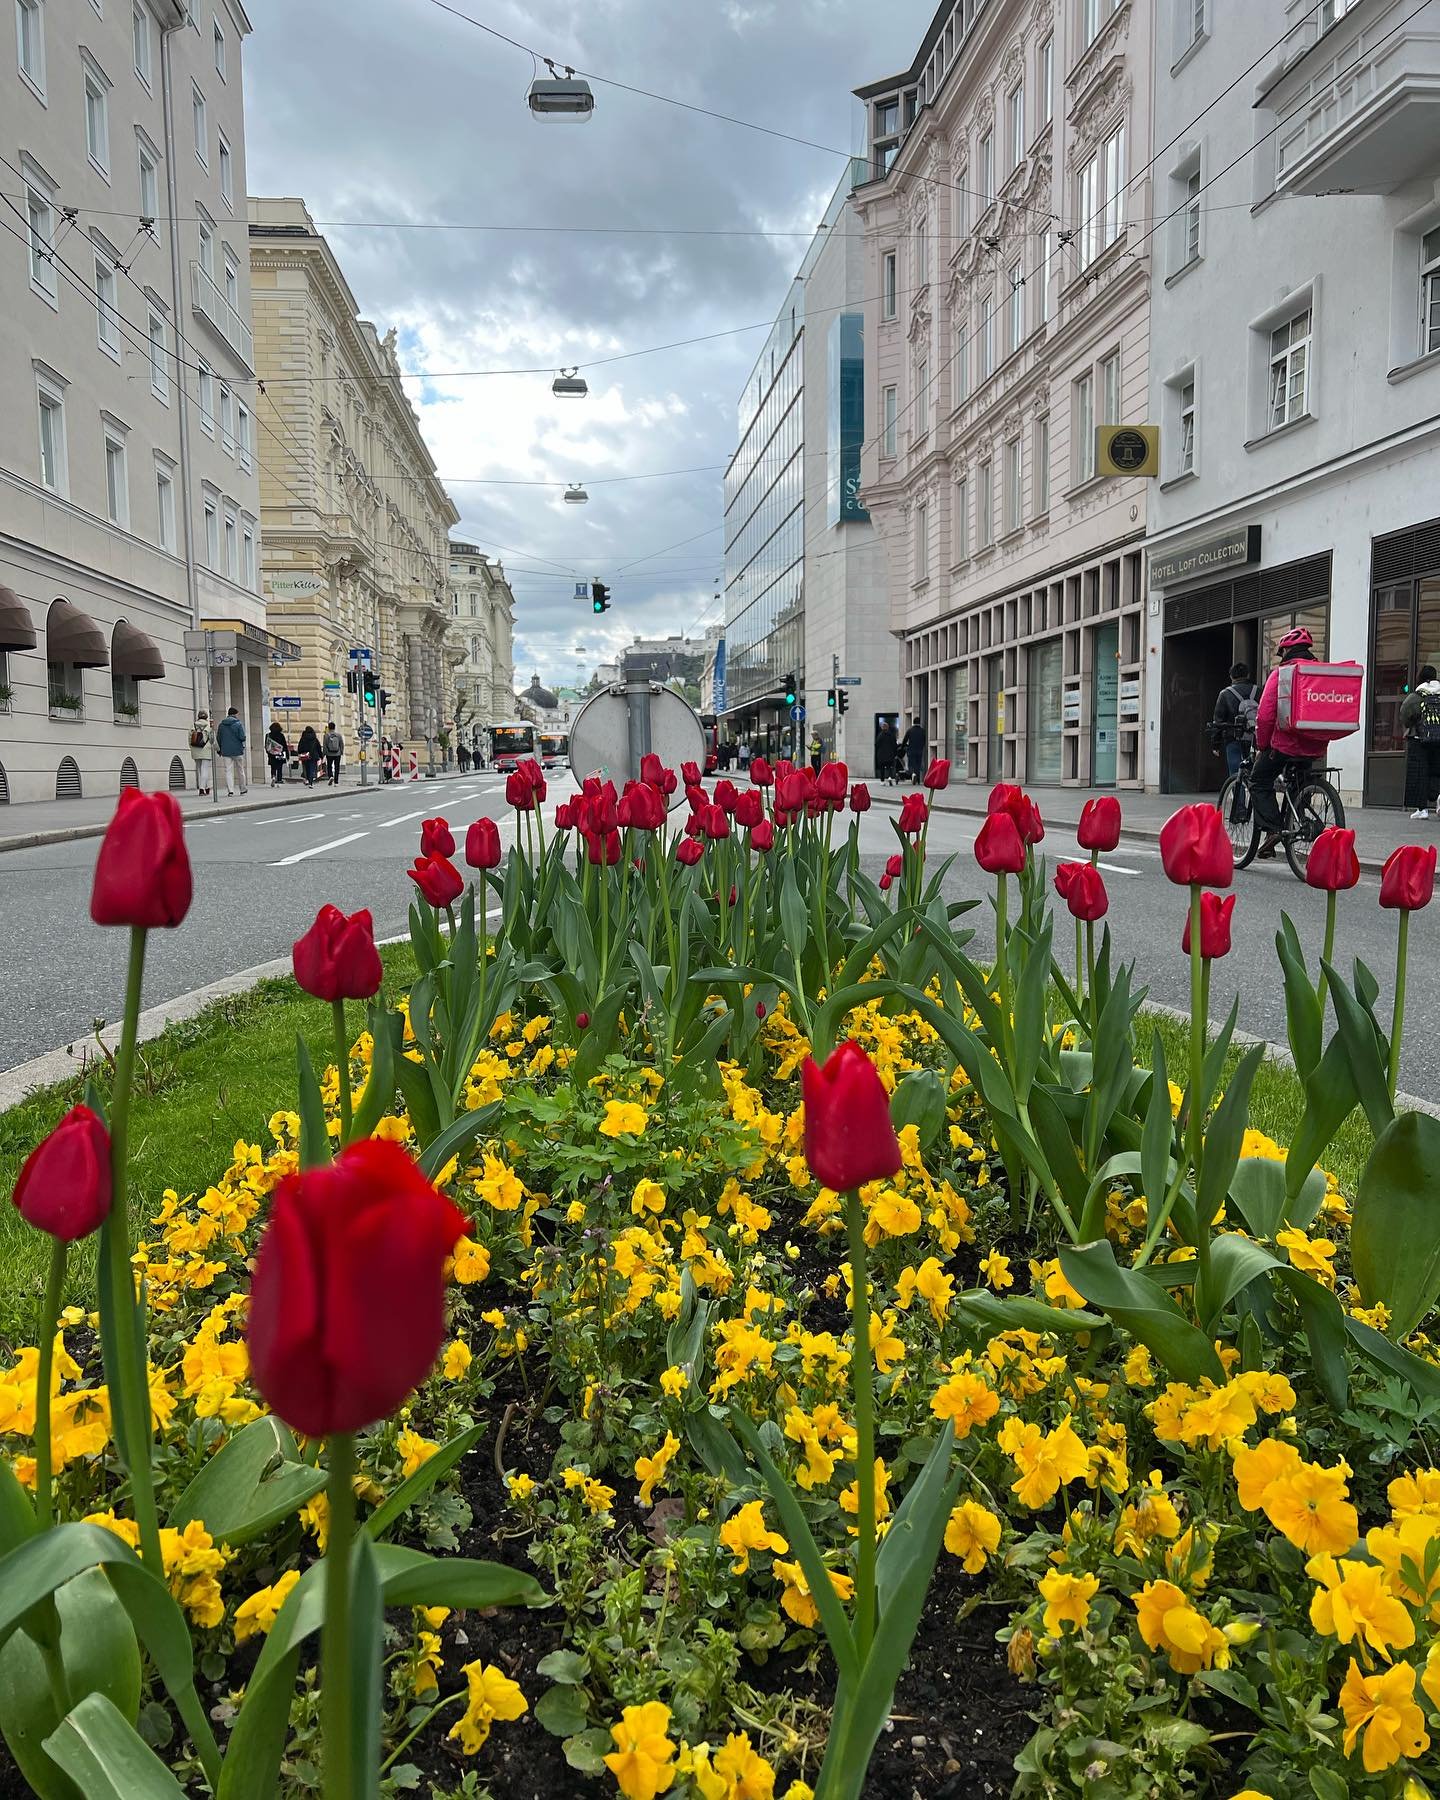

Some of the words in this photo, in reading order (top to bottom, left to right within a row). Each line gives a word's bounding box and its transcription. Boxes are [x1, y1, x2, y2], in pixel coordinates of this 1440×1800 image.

[1151, 563, 1175, 580] HOTEL
[1178, 558, 1197, 572] LOFT
[1198, 541, 1246, 565] COLLECTION
[1306, 688, 1354, 704] foodora
